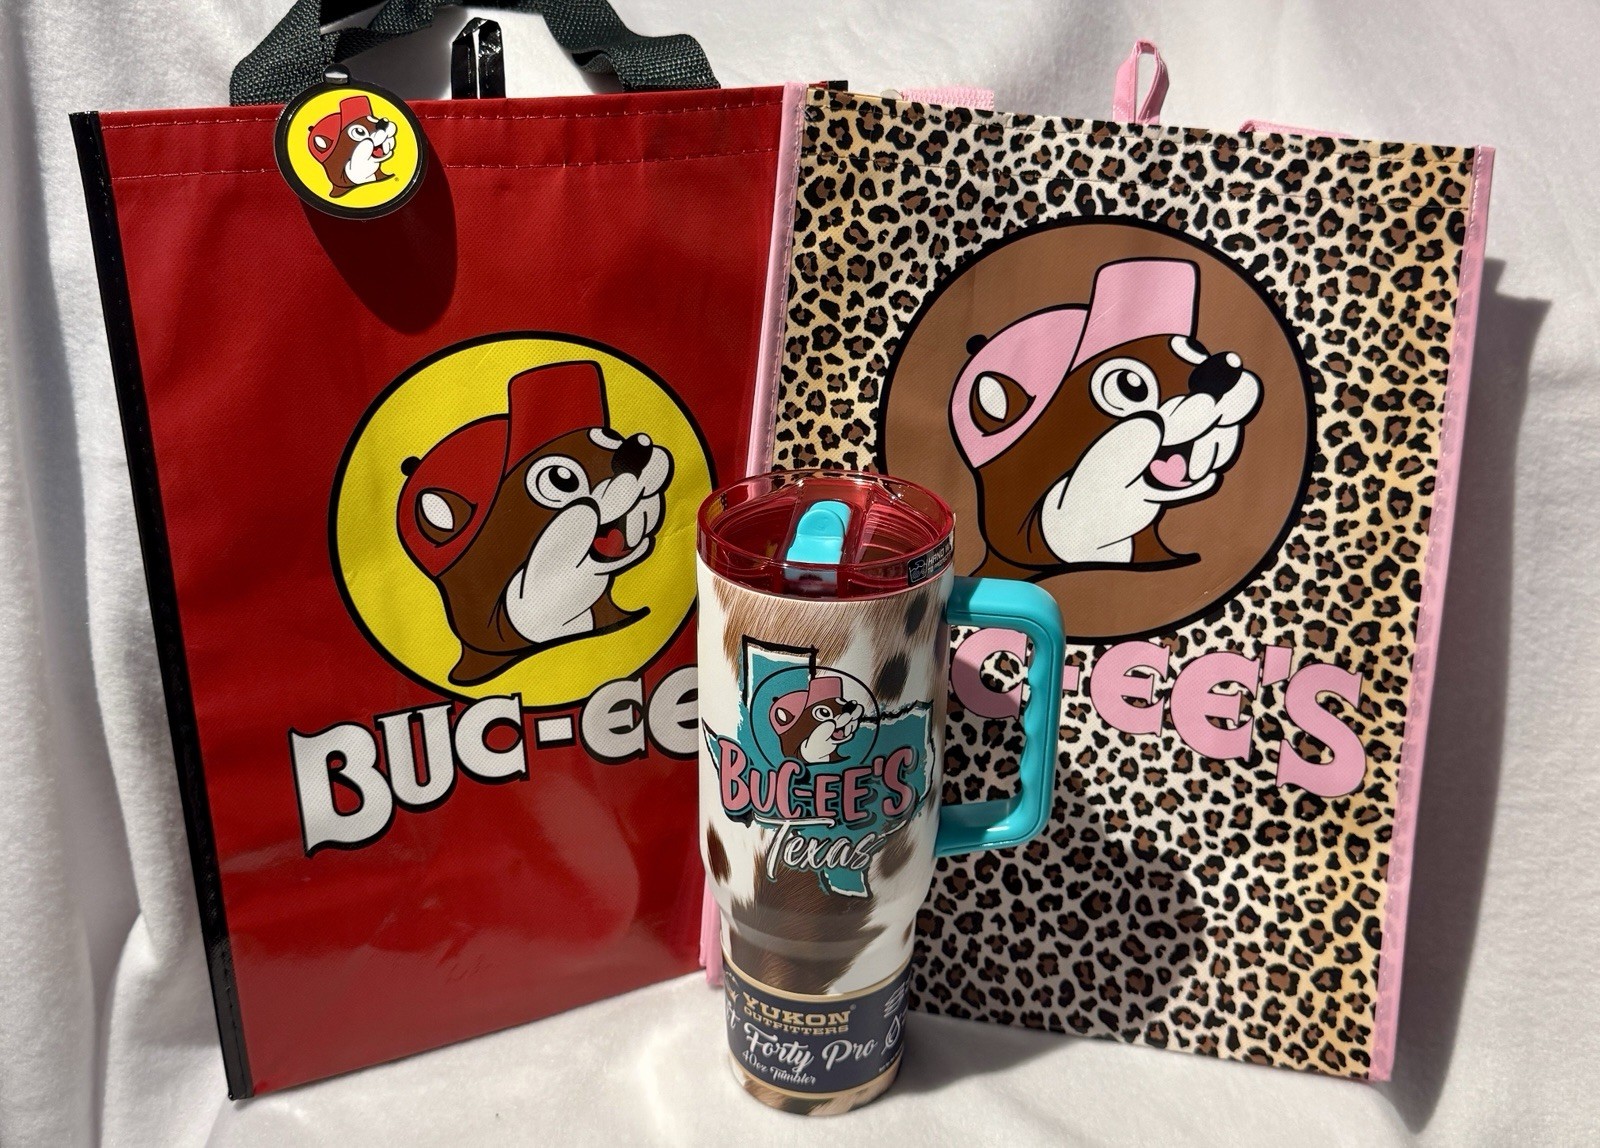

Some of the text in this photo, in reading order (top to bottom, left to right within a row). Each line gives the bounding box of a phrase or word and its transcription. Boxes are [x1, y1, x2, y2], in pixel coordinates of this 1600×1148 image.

[951, 628, 1366, 797] CEE'S
[289, 665, 698, 858] BUC-EE
[718, 737, 918, 824] BUC-EE'S
[754, 813, 906, 880] Texas
[742, 991, 851, 1026] YUKON
[743, 1005, 849, 1035] OUTFITTERS
[742, 1050, 816, 1085] 40oz Tumbler
[743, 1022, 815, 1073] Forty
[822, 1039, 878, 1071] Pro
